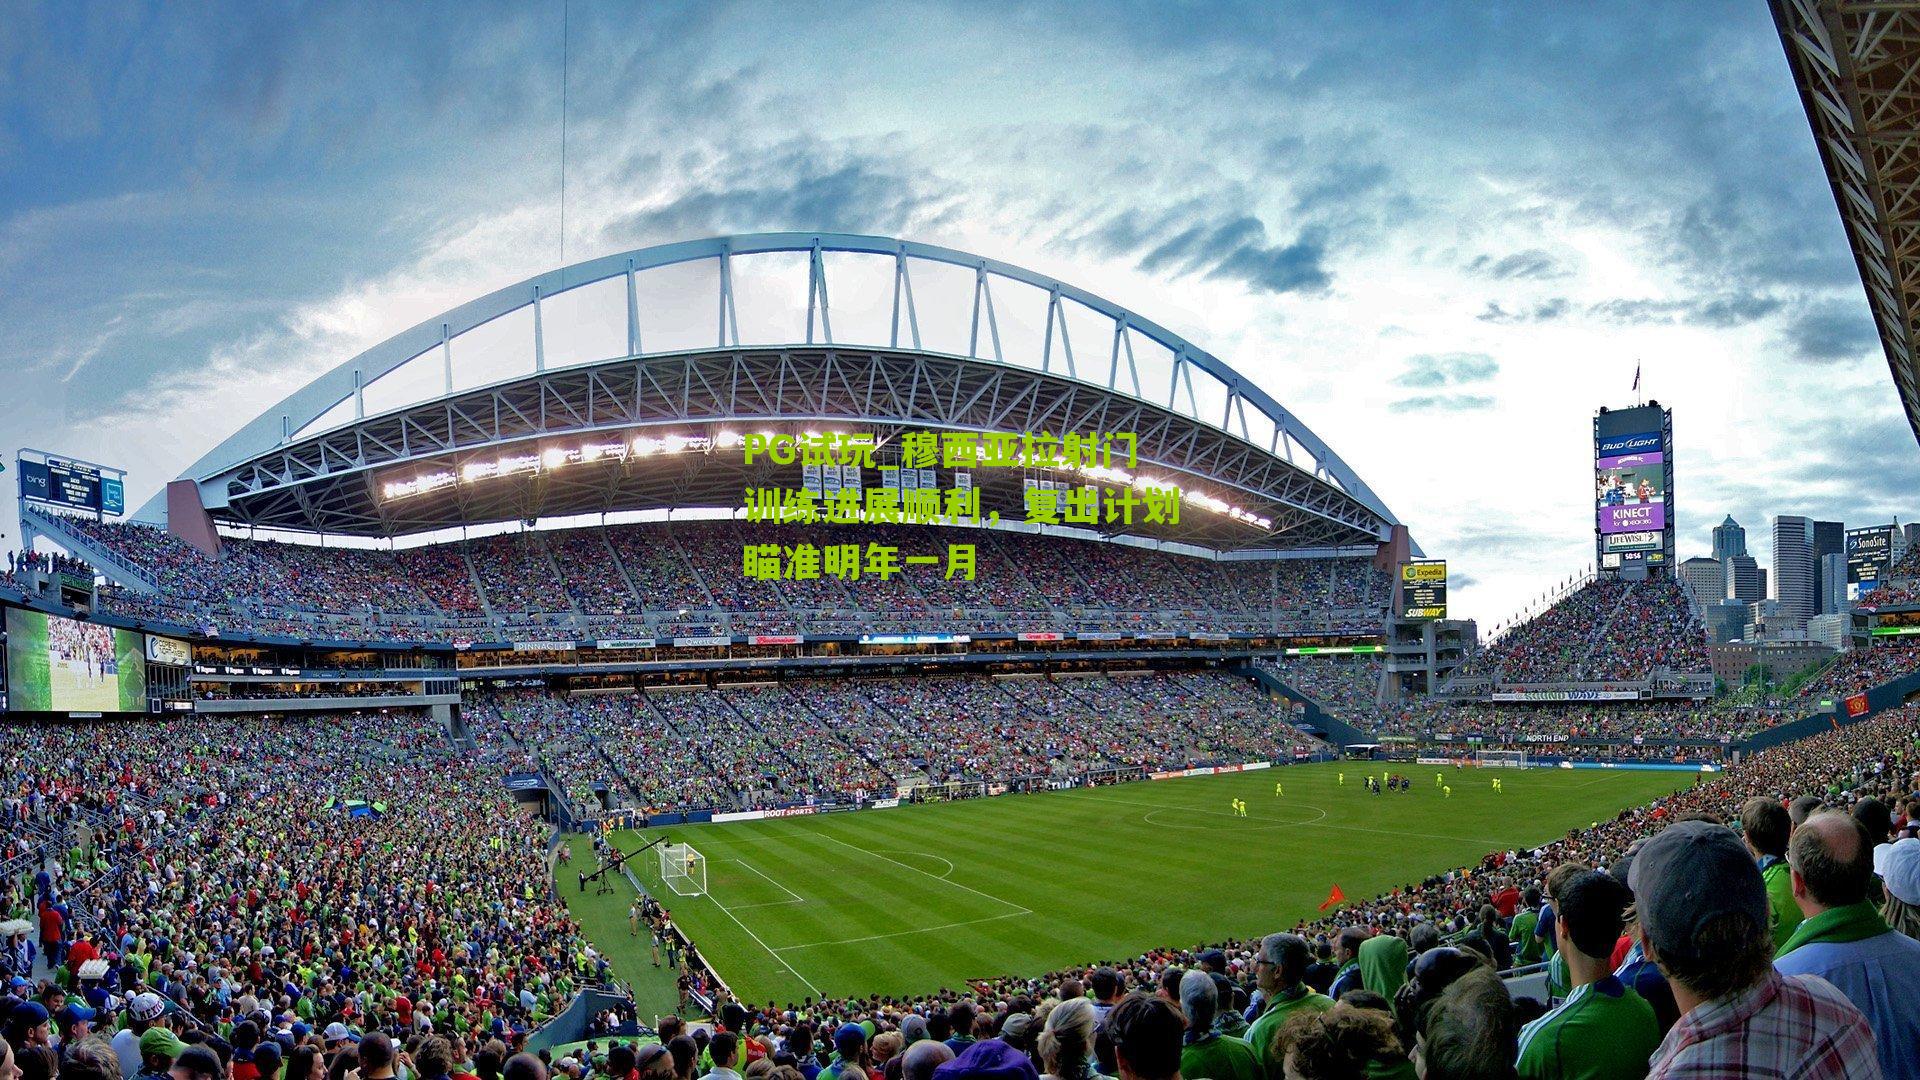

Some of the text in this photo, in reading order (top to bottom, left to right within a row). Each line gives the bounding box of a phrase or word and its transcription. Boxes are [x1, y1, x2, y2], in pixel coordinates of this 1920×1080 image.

[1601, 438, 1658, 451] BUD LIGHT
[26, 474, 46, 487] bing
[1613, 507, 1652, 519] KINECT
[1858, 535, 1886, 549] SonoSite
[1416, 568, 1443, 576] Expedia
[1405, 608, 1444, 618] SUBWAY
[517, 642, 565, 651] PINNACLE
[1526, 734, 1569, 742] NORTH END
[764, 810, 785, 818] ROOT
